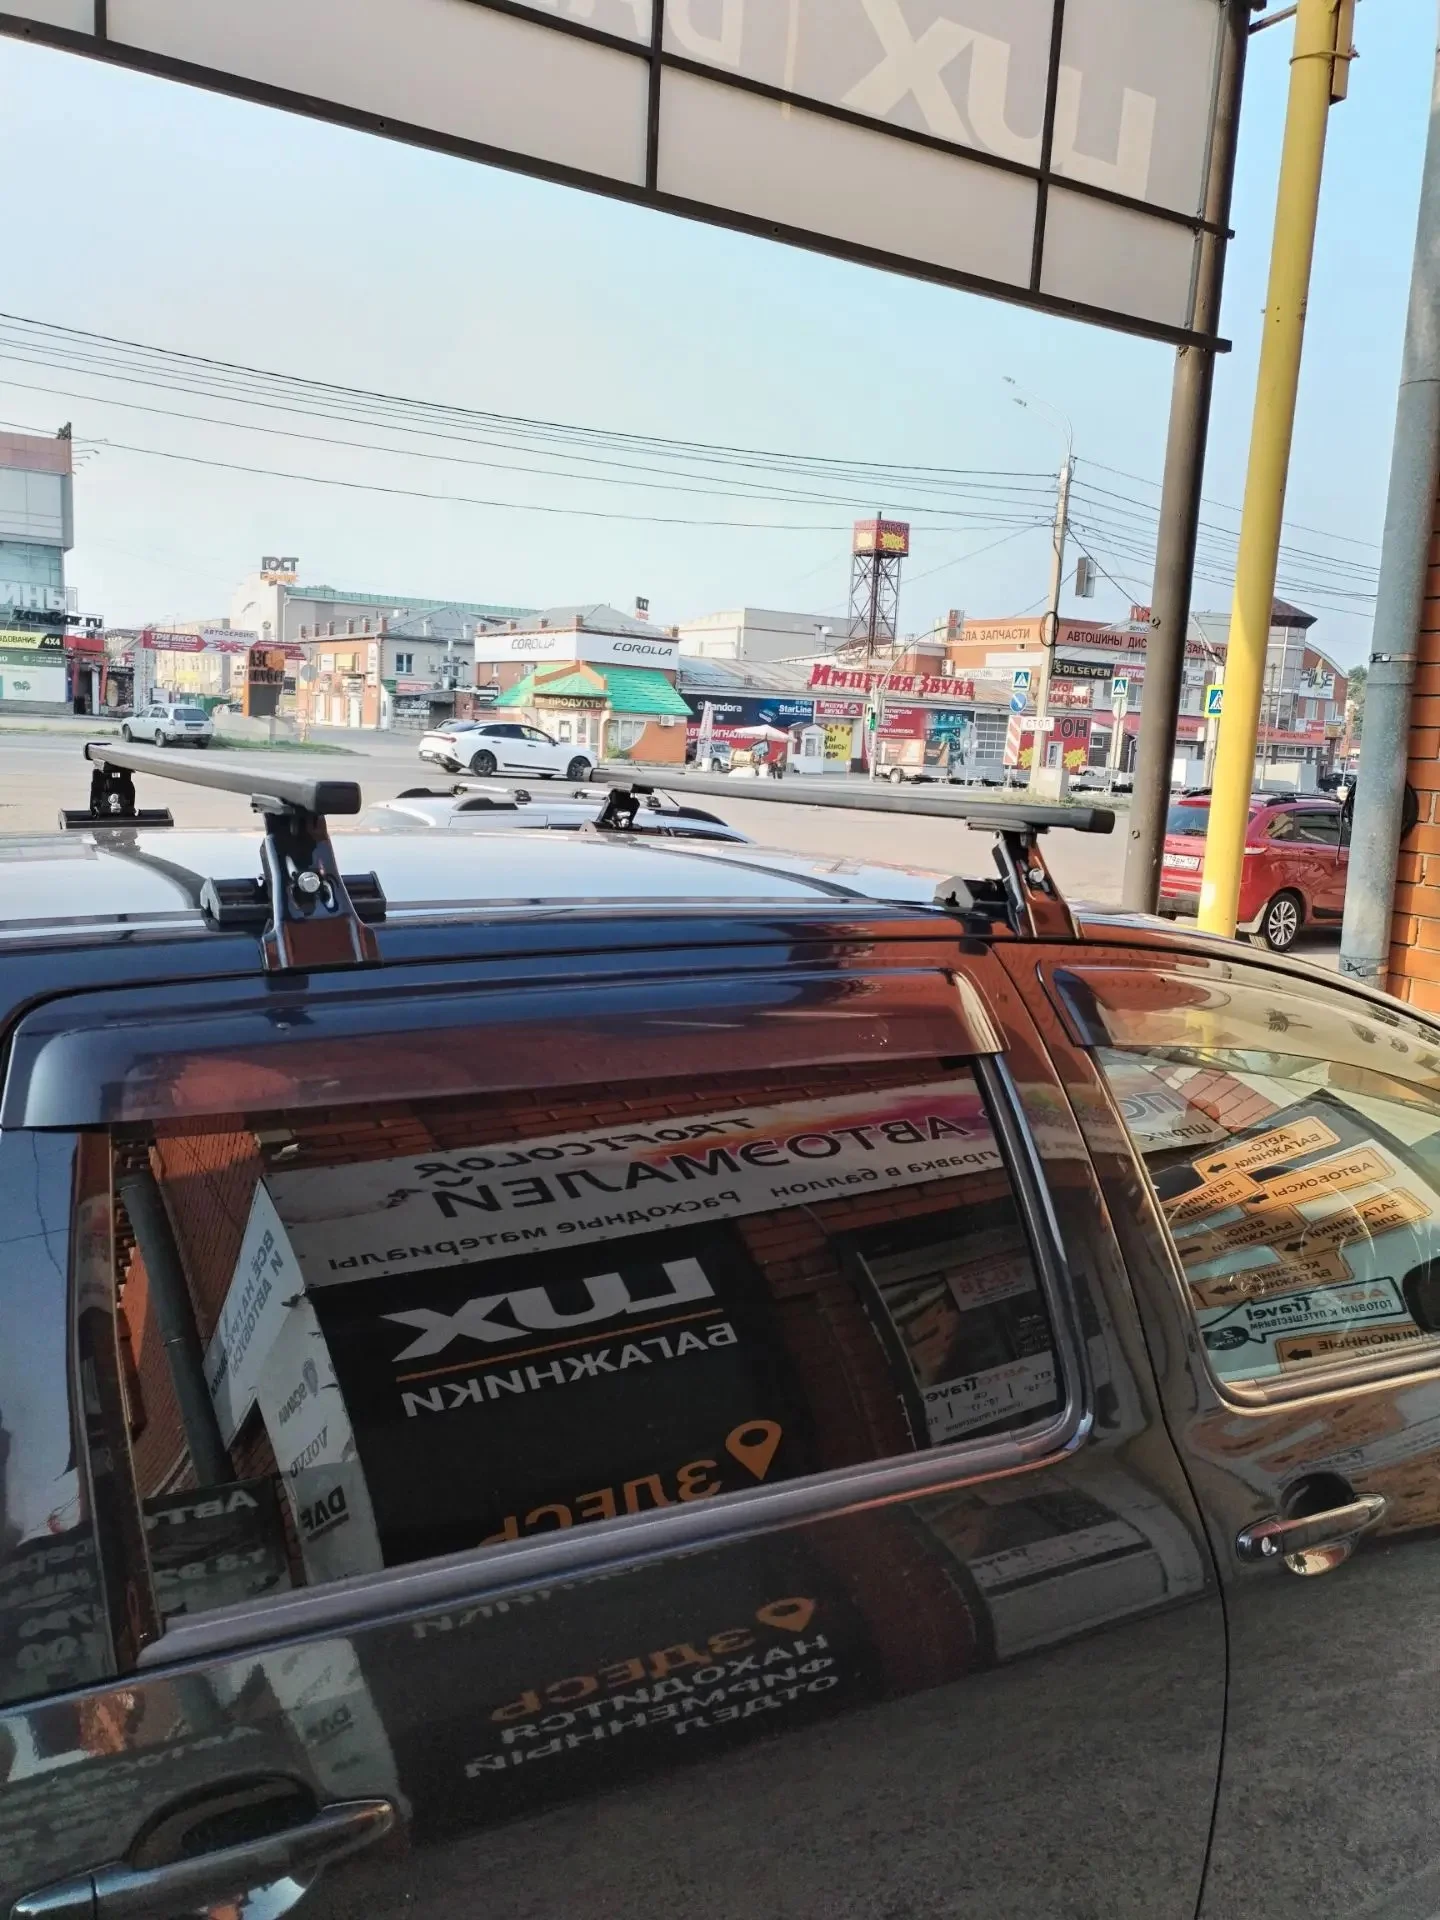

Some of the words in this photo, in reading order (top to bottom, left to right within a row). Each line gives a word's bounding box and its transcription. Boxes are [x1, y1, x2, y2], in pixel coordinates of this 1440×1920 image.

[151, 632, 171, 642] ТРИ
[172, 635, 198, 643] ИКСА
[204, 629, 255, 639] АВТОСЕРВИС
[981, 628, 1030, 641] ЗАПЧАСТИ
[1067, 630, 1123, 646] АВТОШИНЫ
[1128, 637, 1148, 649] ДИС
[511, 638, 556, 651] COROLLA
[613, 642, 673, 657] COROLLA
[549, 697, 602, 709] ПРОДУКТЫ
[779, 704, 812, 714] StarLine
